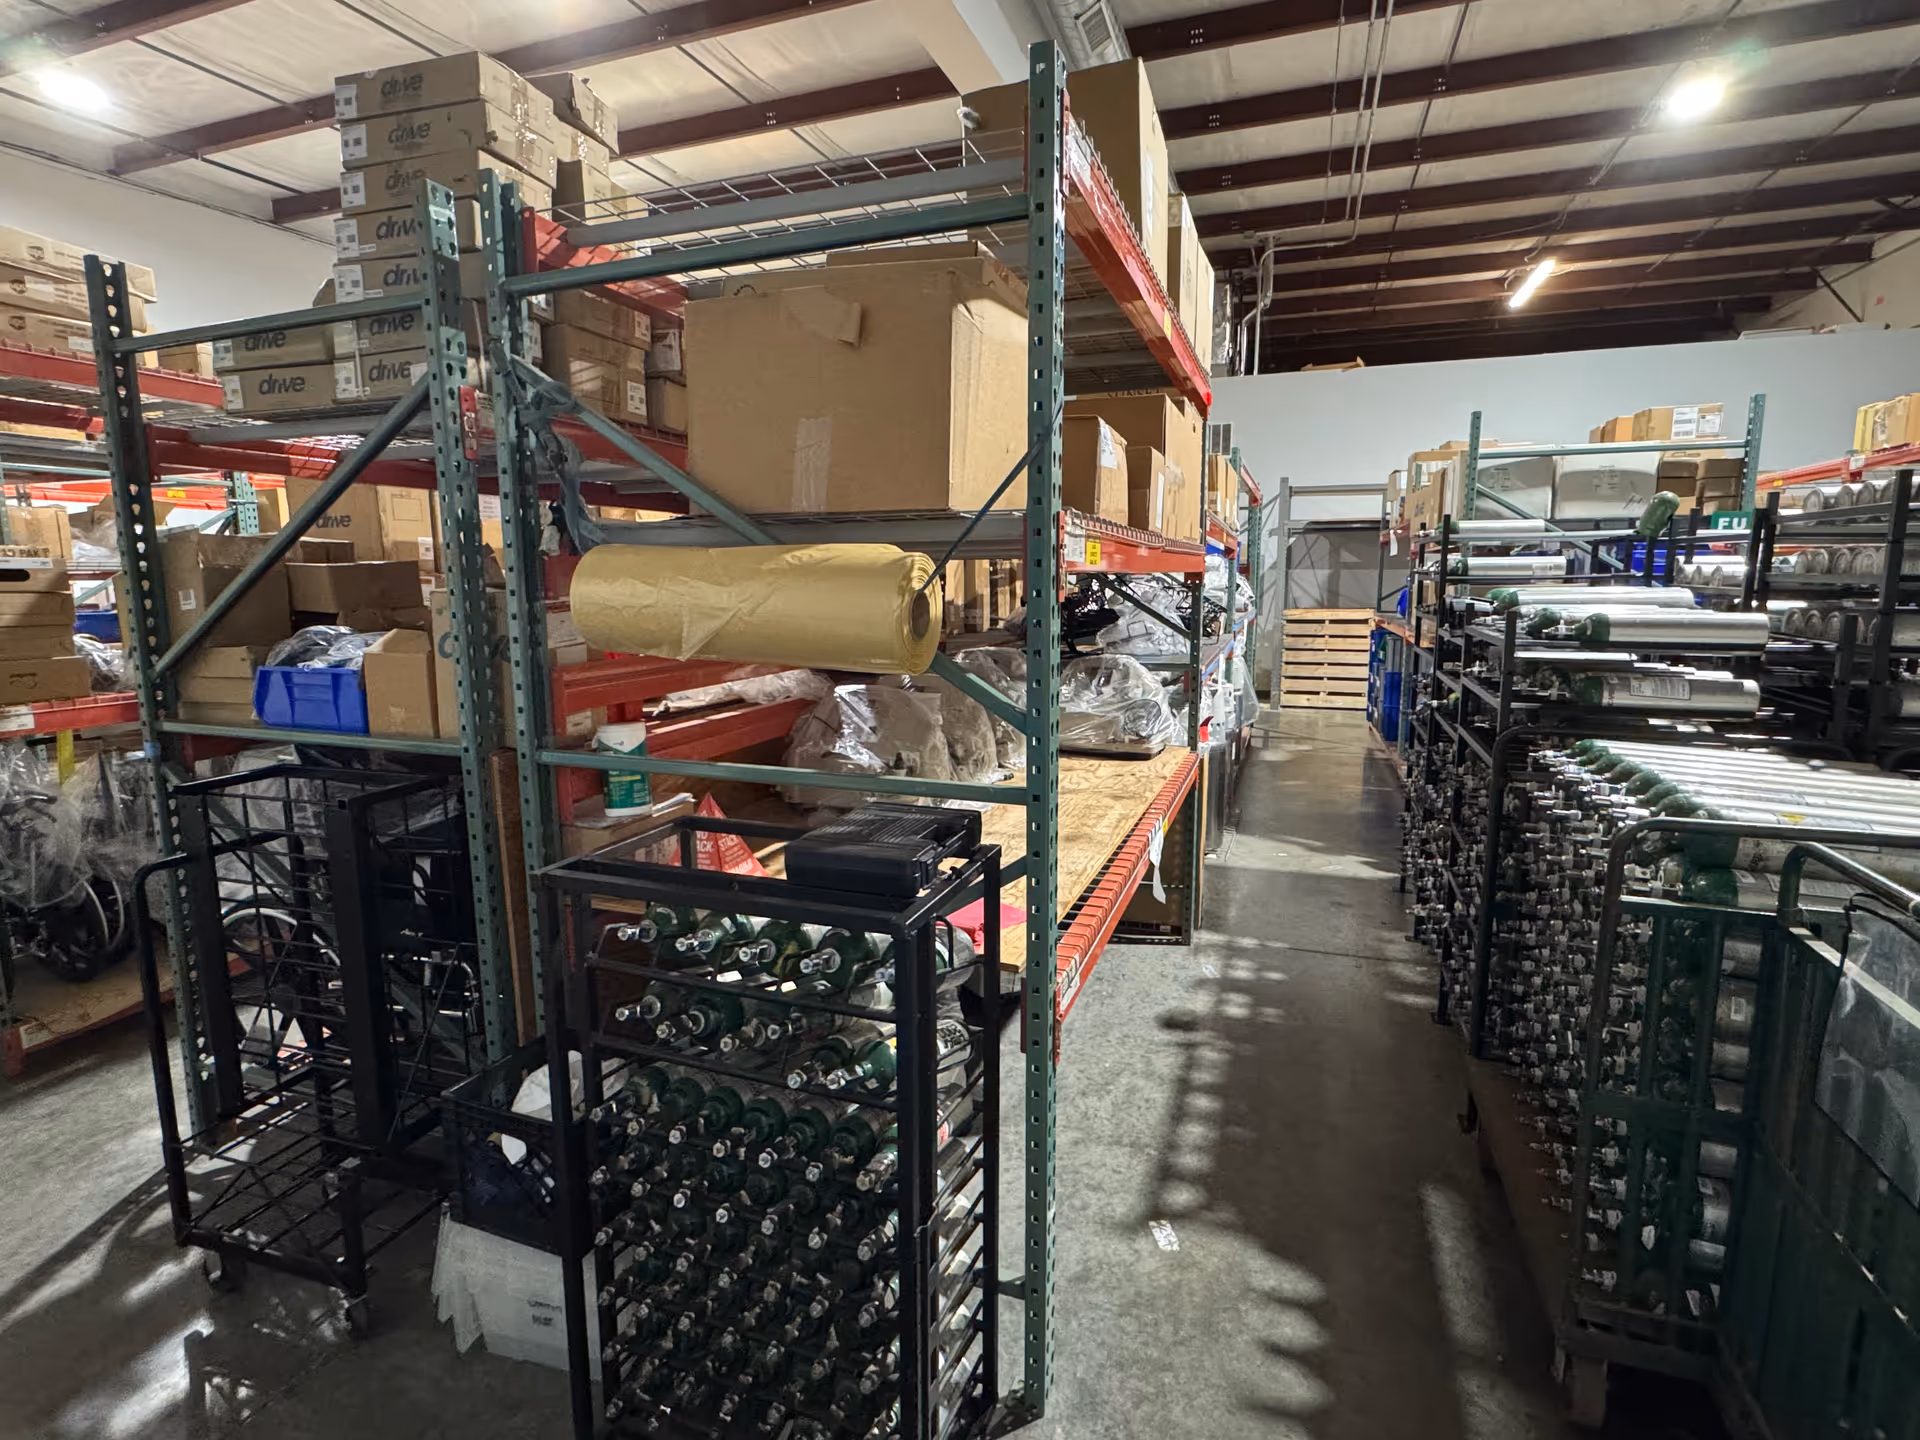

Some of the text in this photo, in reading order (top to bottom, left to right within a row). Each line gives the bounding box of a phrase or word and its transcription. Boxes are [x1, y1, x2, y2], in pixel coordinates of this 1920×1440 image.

[381, 74, 424, 98] drive
[387, 121, 432, 145] drive
[368, 358, 411, 382] drive
[259, 373, 305, 395] drive
[315, 512, 351, 529] drive
